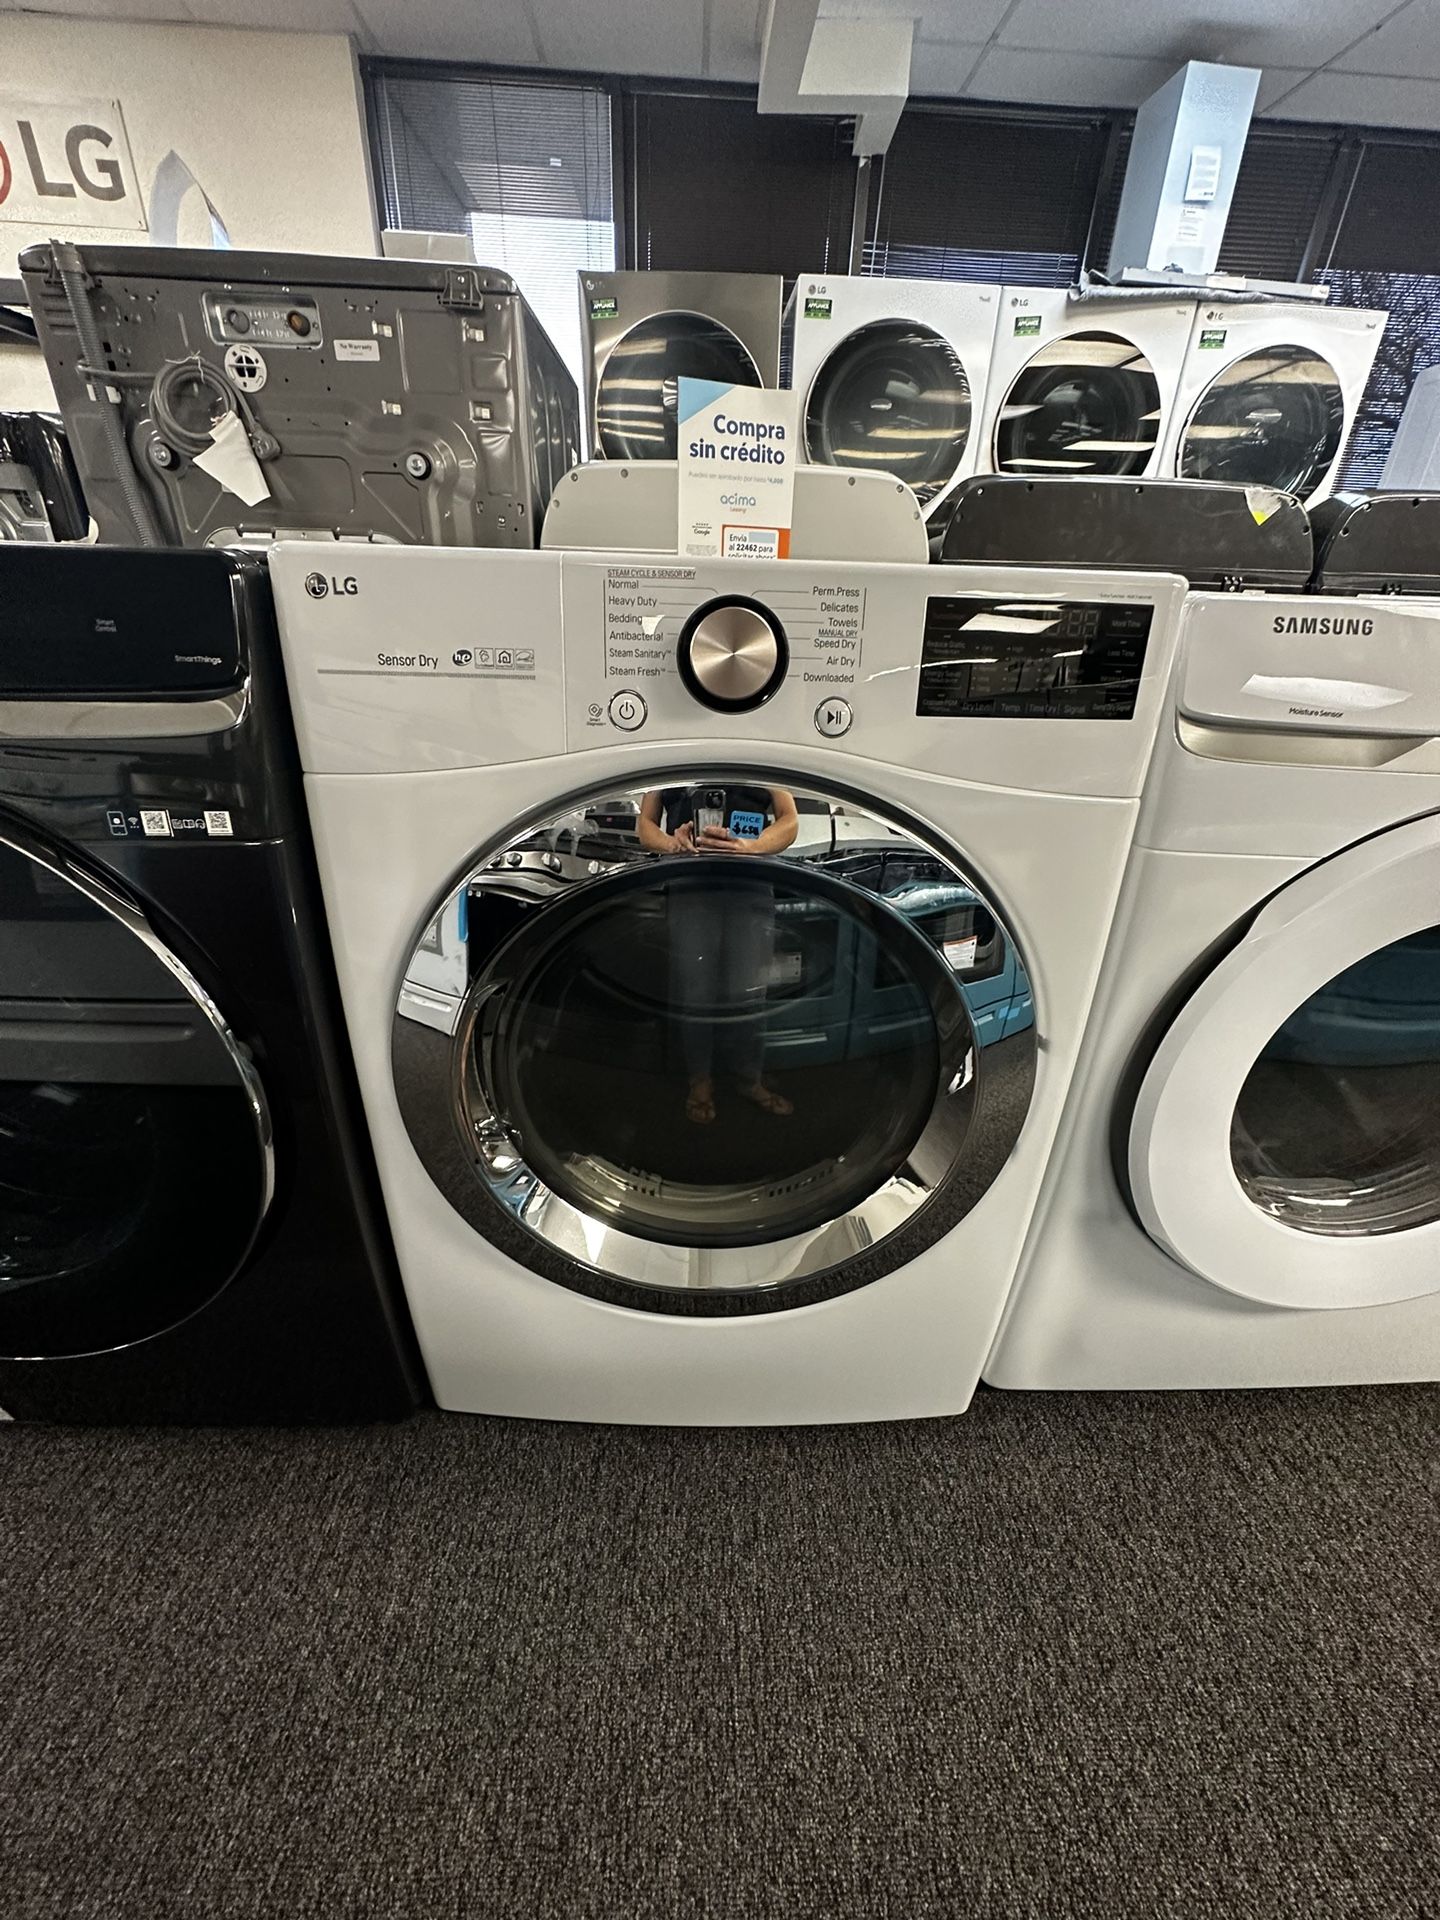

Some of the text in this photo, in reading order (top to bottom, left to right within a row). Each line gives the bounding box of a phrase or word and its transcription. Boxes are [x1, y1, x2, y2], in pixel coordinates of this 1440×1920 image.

[17, 120, 126, 201] LG
[817, 285, 827, 294] LG
[1019, 298, 1029, 306] LG
[713, 414, 785, 442] Compra
[689, 438, 785, 465] sin crédito
[720, 493, 756, 506] acima
[736, 543, 757, 551] 22462
[607, 569, 697, 579] STEAM CYCLE & SENSOR DRY
[332, 576, 358, 596] LG
[608, 579, 639, 589] Normal
[813, 586, 860, 597] Perm.Press
[608, 596, 657, 607] Heavy Duty
[820, 602, 859, 613] Delicates
[608, 613, 643, 625] Bedding
[828, 618, 858, 627] Towels
[1273, 616, 1374, 636] SAMSUNG
[609, 631, 663, 641] Antibacterial
[818, 629, 844, 637] MANUAL
[814, 638, 856, 649] Speed Dry
[609, 648, 633, 658] Steam
[174, 654, 222, 665] SmartThings
[377, 653, 439, 670] Sensor Dry
[826, 656, 856, 667] Air Dry
[609, 666, 635, 676] Steam
[803, 673, 854, 682] Downloaded
[1288, 707, 1344, 718] Moisture Sensor
[733, 815, 761, 823] PRICE
